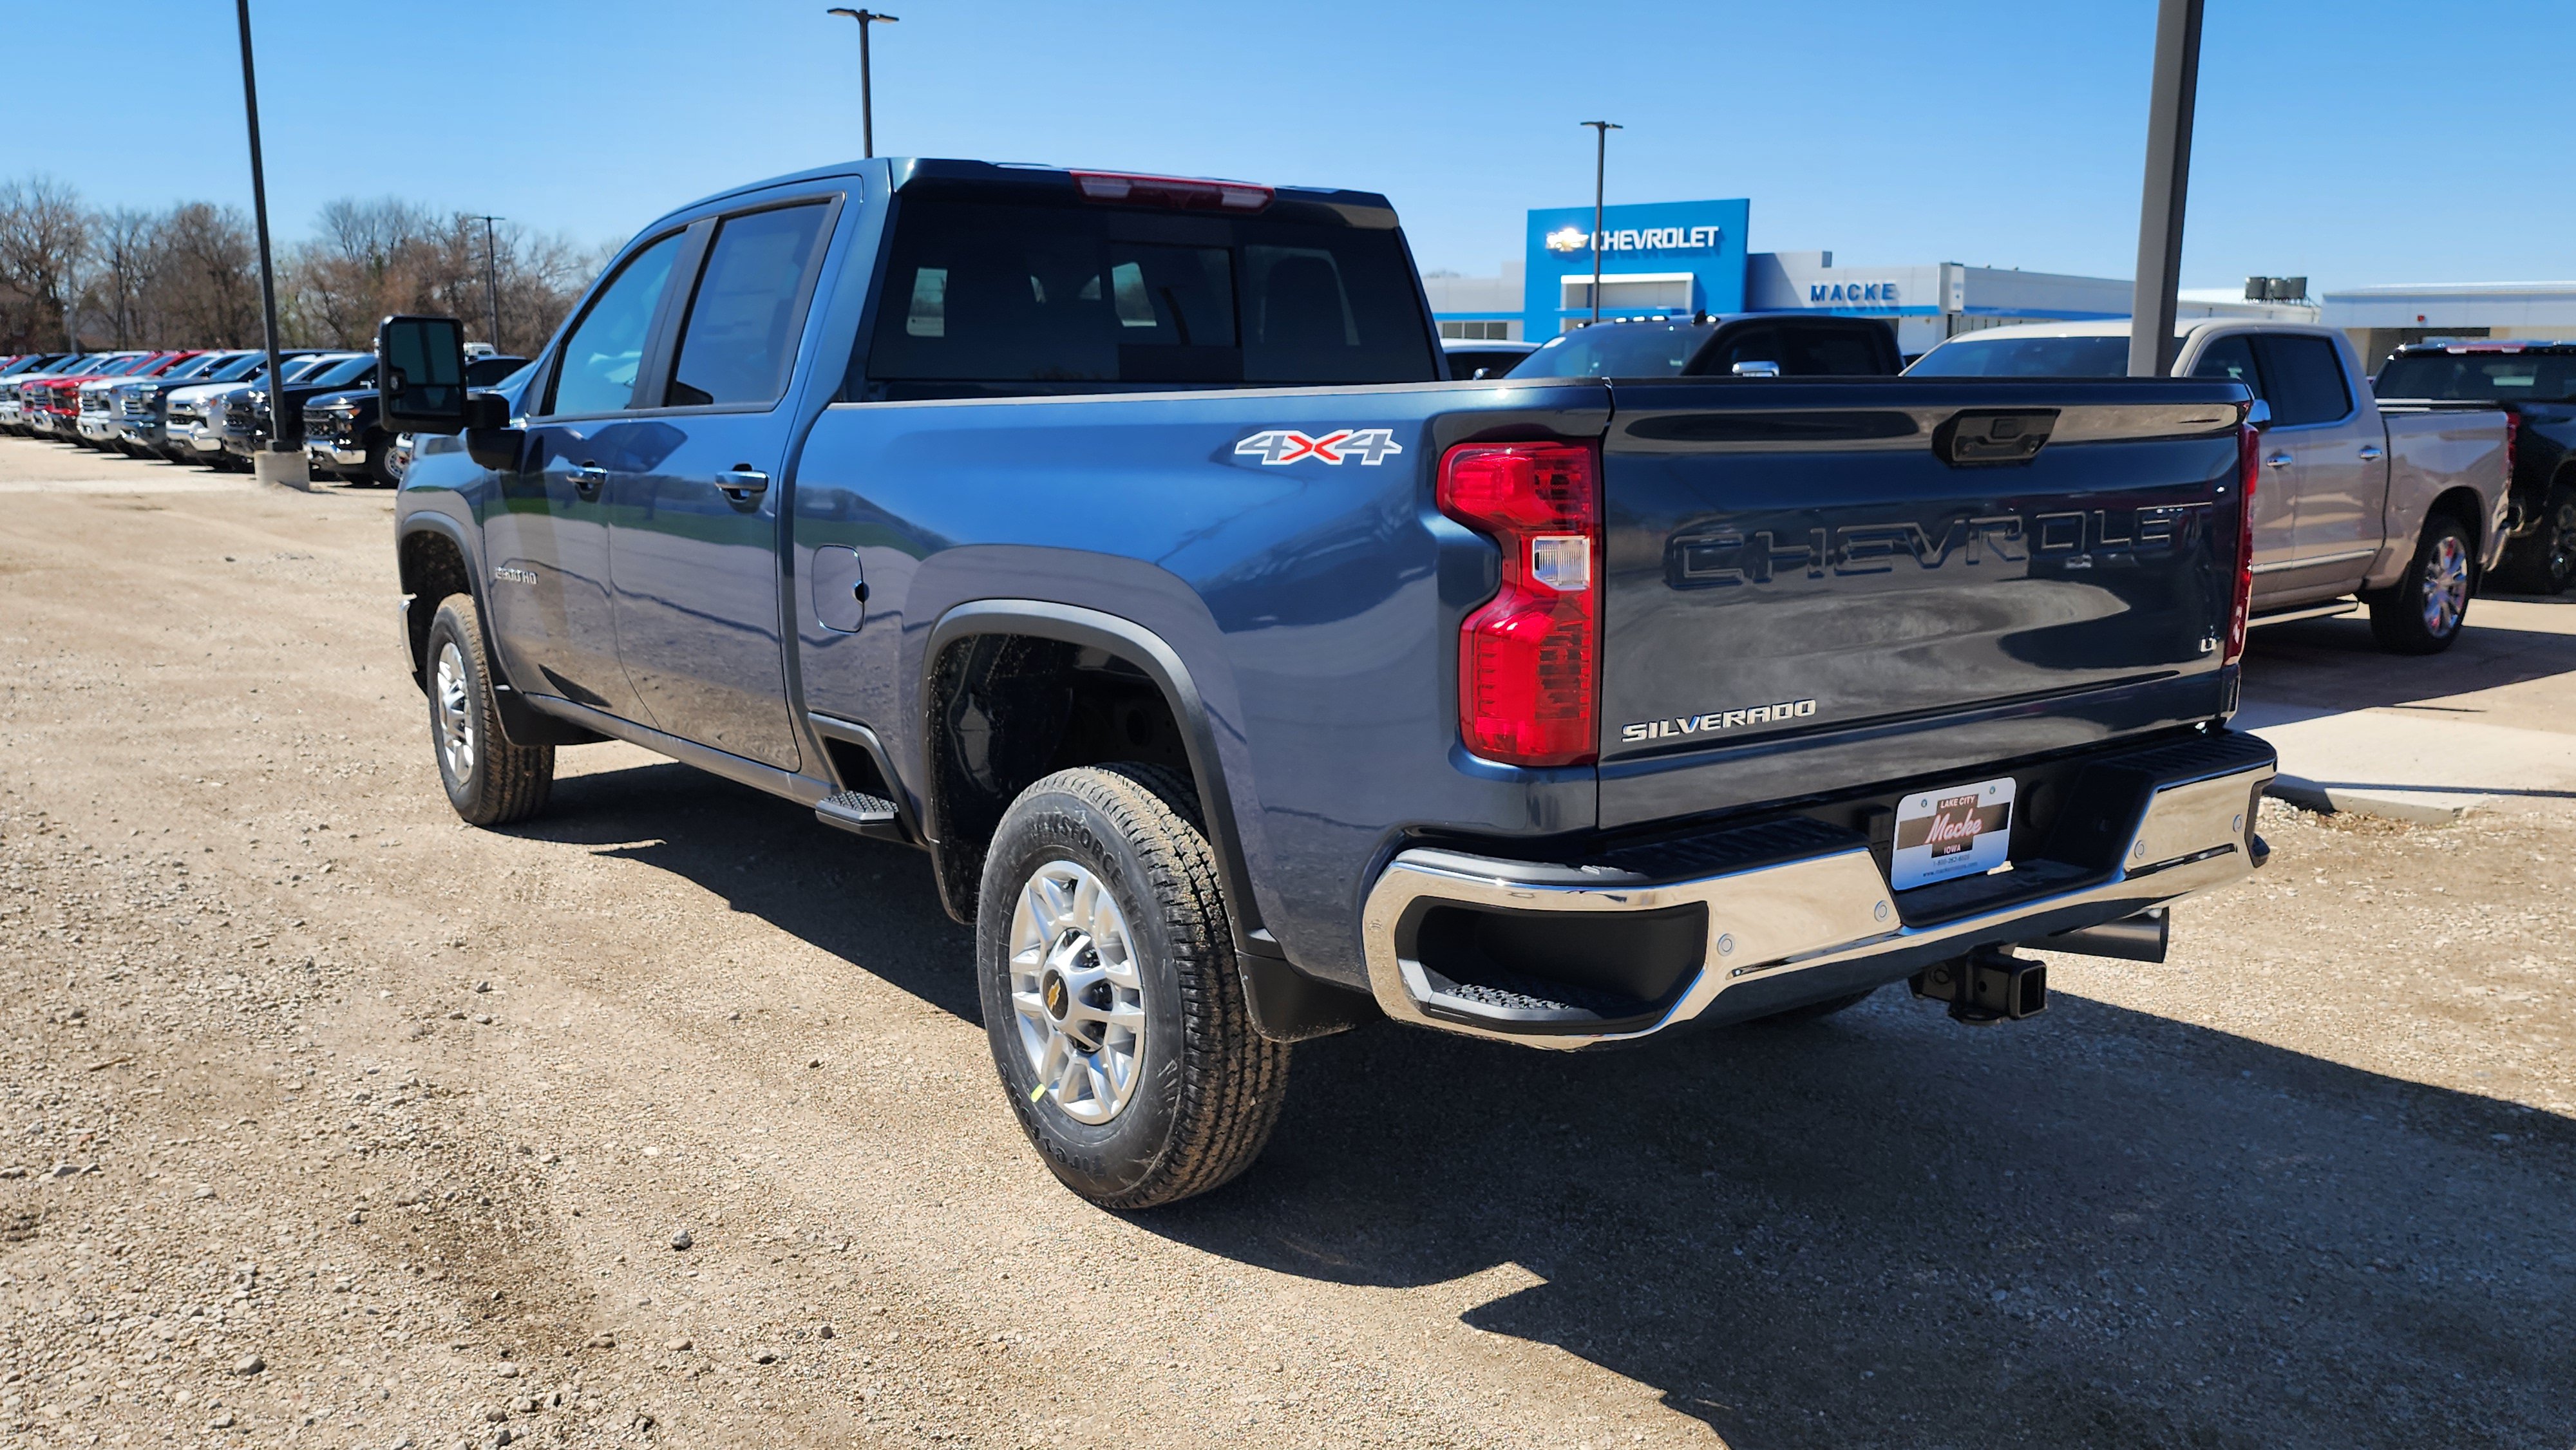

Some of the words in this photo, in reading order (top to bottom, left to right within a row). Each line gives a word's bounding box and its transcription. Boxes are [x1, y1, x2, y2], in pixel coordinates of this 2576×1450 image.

[1591, 226, 1719, 251] CHEVROLET
[1811, 283, 1897, 301] MACKE
[1665, 501, 2213, 590] CHEVROLET
[1622, 699, 1816, 742] SILVERADO
[1941, 798, 1958, 808] LAKE
[1959, 796, 1975, 805] CITY
[1924, 808, 1982, 844] Macke
[1944, 845, 1961, 854] IOWA
